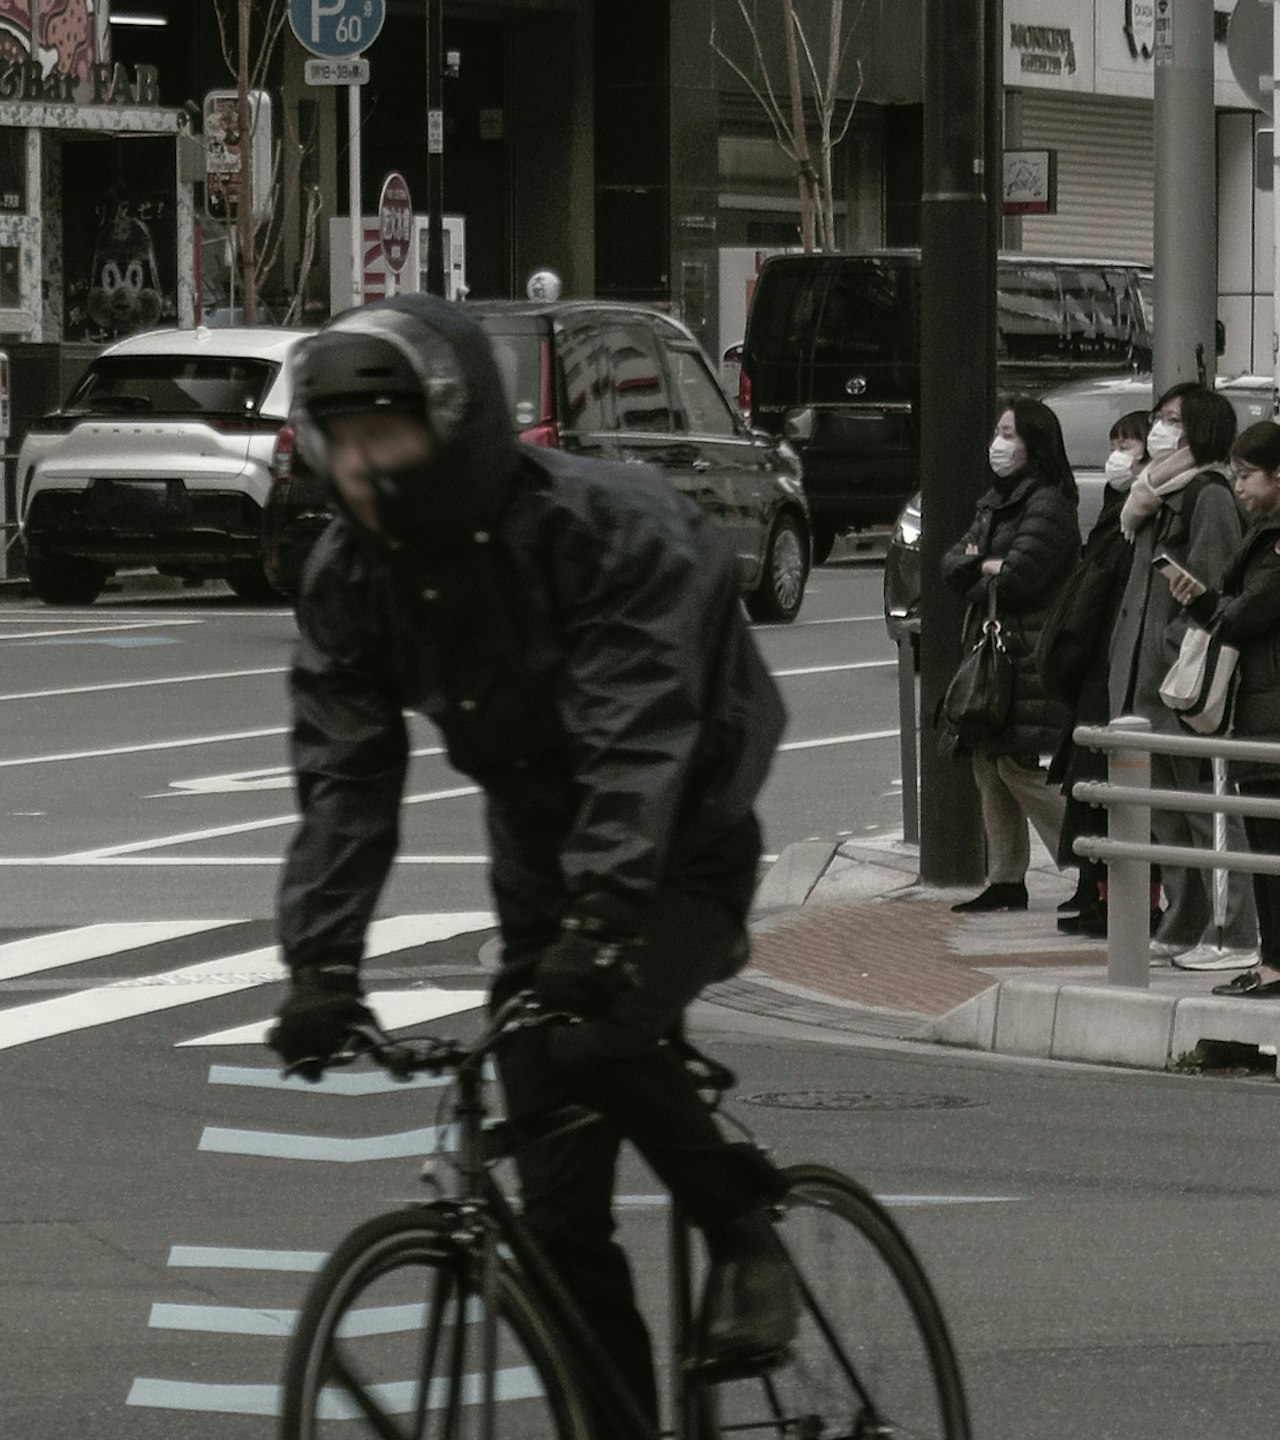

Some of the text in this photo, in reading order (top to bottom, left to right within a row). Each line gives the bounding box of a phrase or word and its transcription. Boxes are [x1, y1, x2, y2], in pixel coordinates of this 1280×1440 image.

[311, 0, 346, 43] P
[335, 15, 362, 43] 60
[91, 63, 159, 106] FAB
